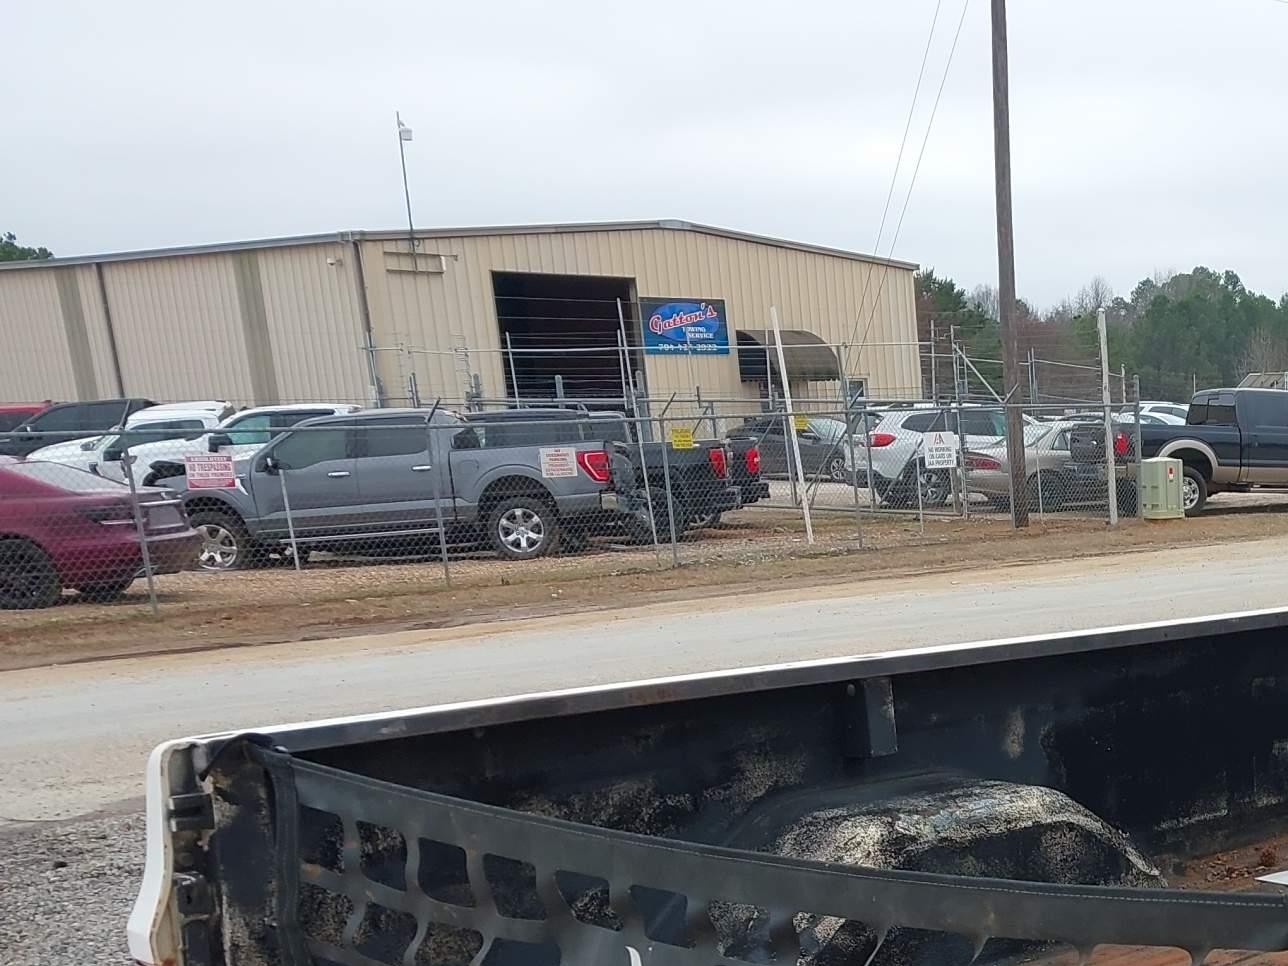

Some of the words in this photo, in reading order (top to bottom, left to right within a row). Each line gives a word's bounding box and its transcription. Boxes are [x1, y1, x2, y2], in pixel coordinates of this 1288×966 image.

[649, 303, 718, 334] Gatton's
[687, 332, 714, 340] SERVICE
[197, 463, 232, 471] TRESPASSING
